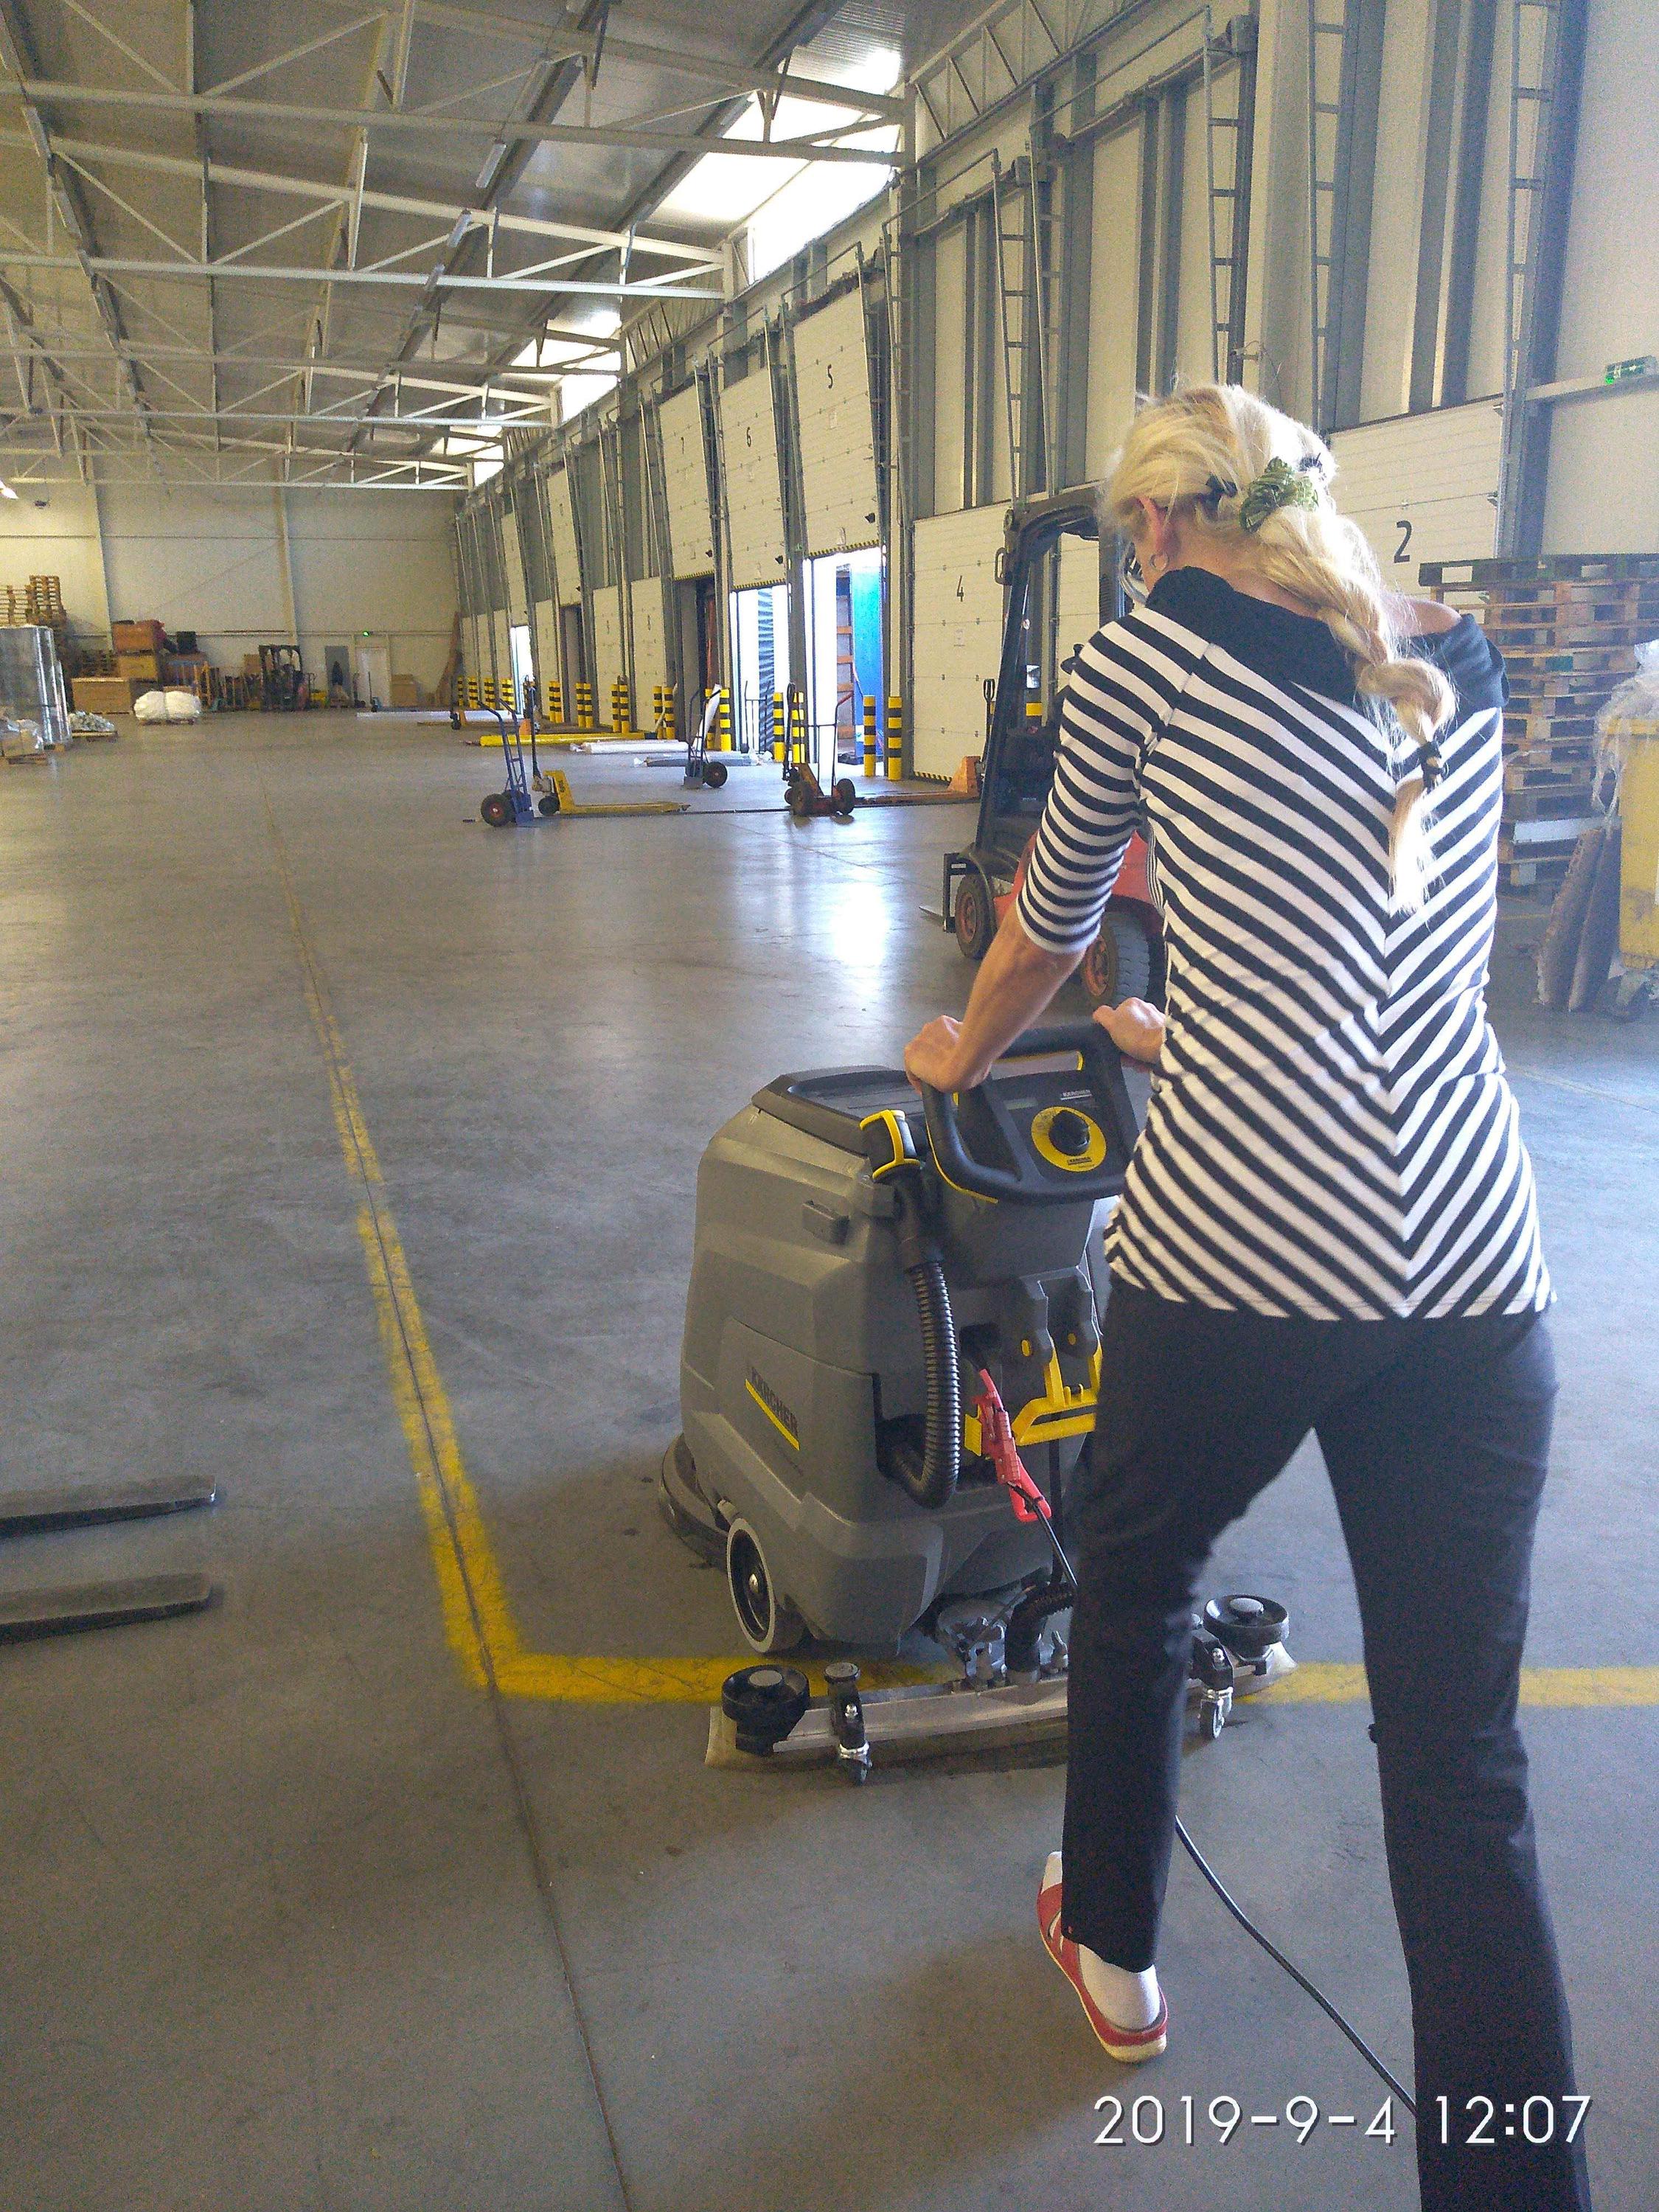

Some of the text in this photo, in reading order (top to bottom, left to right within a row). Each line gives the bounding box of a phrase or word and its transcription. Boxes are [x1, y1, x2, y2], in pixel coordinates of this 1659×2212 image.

[827, 364, 834, 389] 5
[746, 426, 752, 448] 6
[1393, 520, 1412, 564] 2
[956, 575, 964, 602] 4
